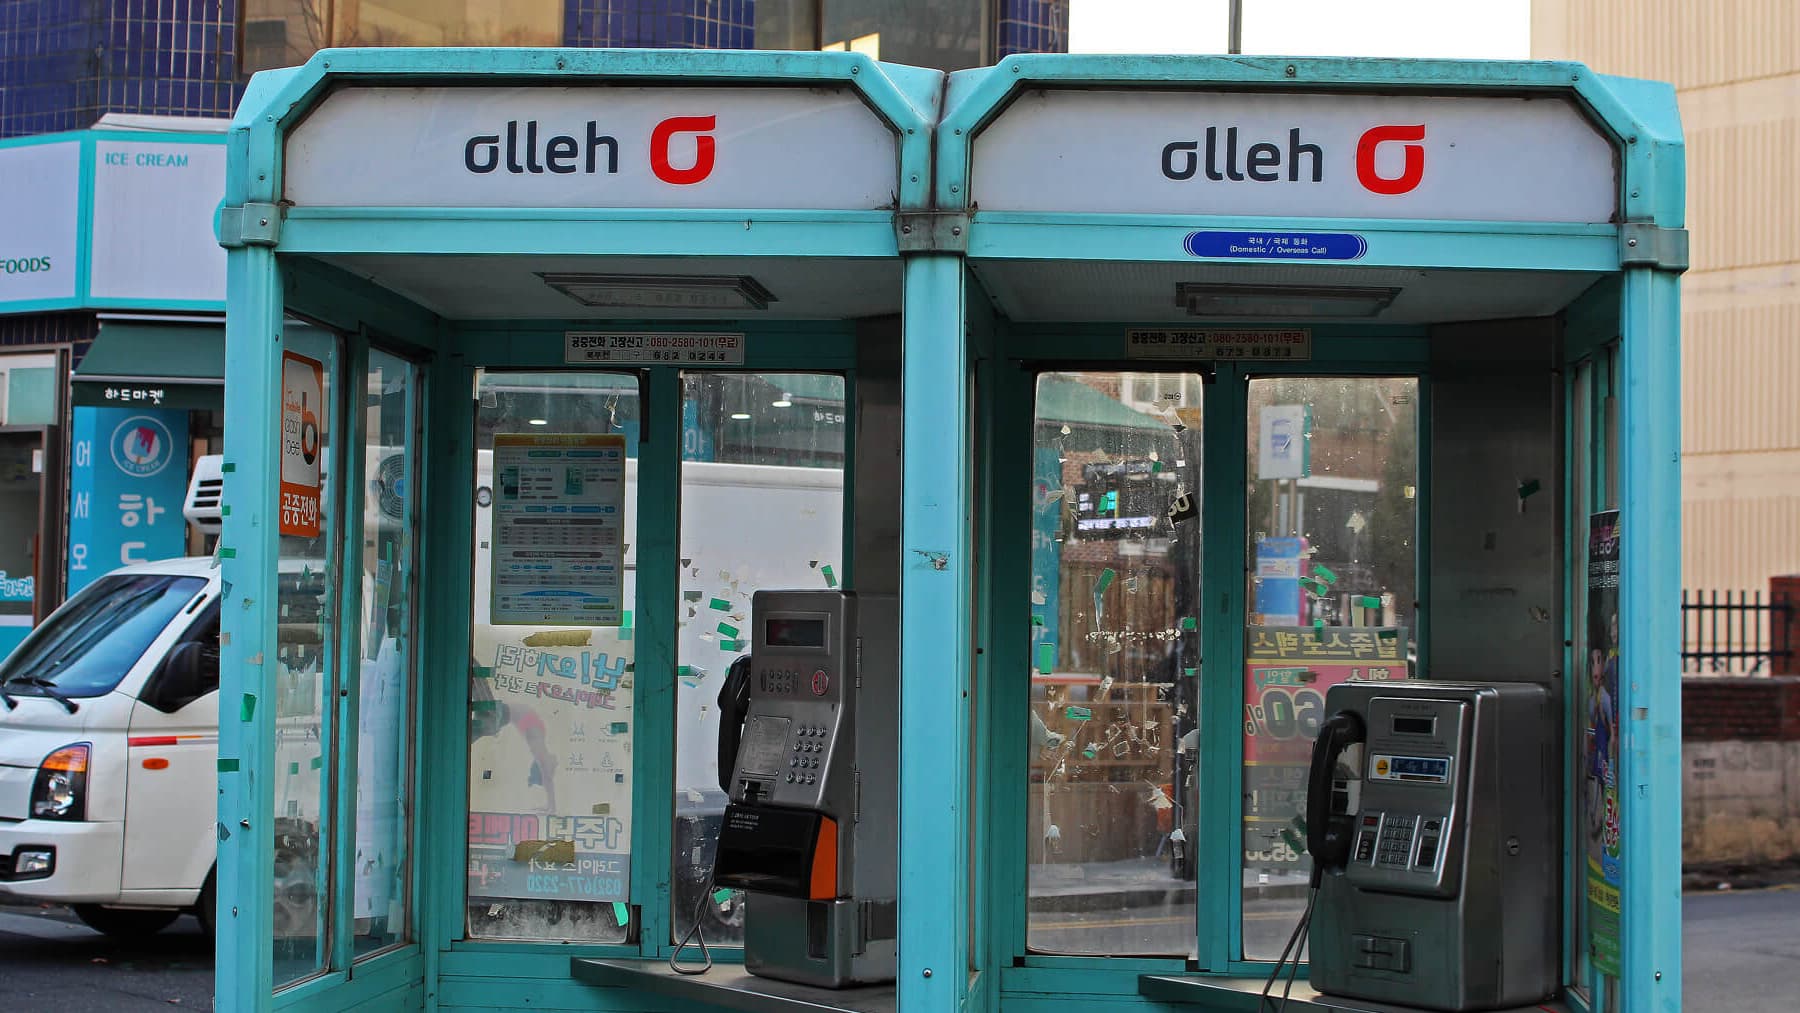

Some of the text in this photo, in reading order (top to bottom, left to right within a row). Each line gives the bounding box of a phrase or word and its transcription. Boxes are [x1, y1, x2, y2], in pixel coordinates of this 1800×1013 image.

[464, 120, 619, 174] olleh
[1161, 126, 1323, 182] olleh
[105, 152, 189, 168] ICE CREAM
[1229, 245, 1267, 254] (Domestic
[1276, 246, 1309, 255] Overseas
[1311, 247, 1328, 256] Call)
[609, 336, 644, 348] 고장신고
[104, 387, 164, 405] 하드마켓
[282, 492, 317, 528] 공중전화
